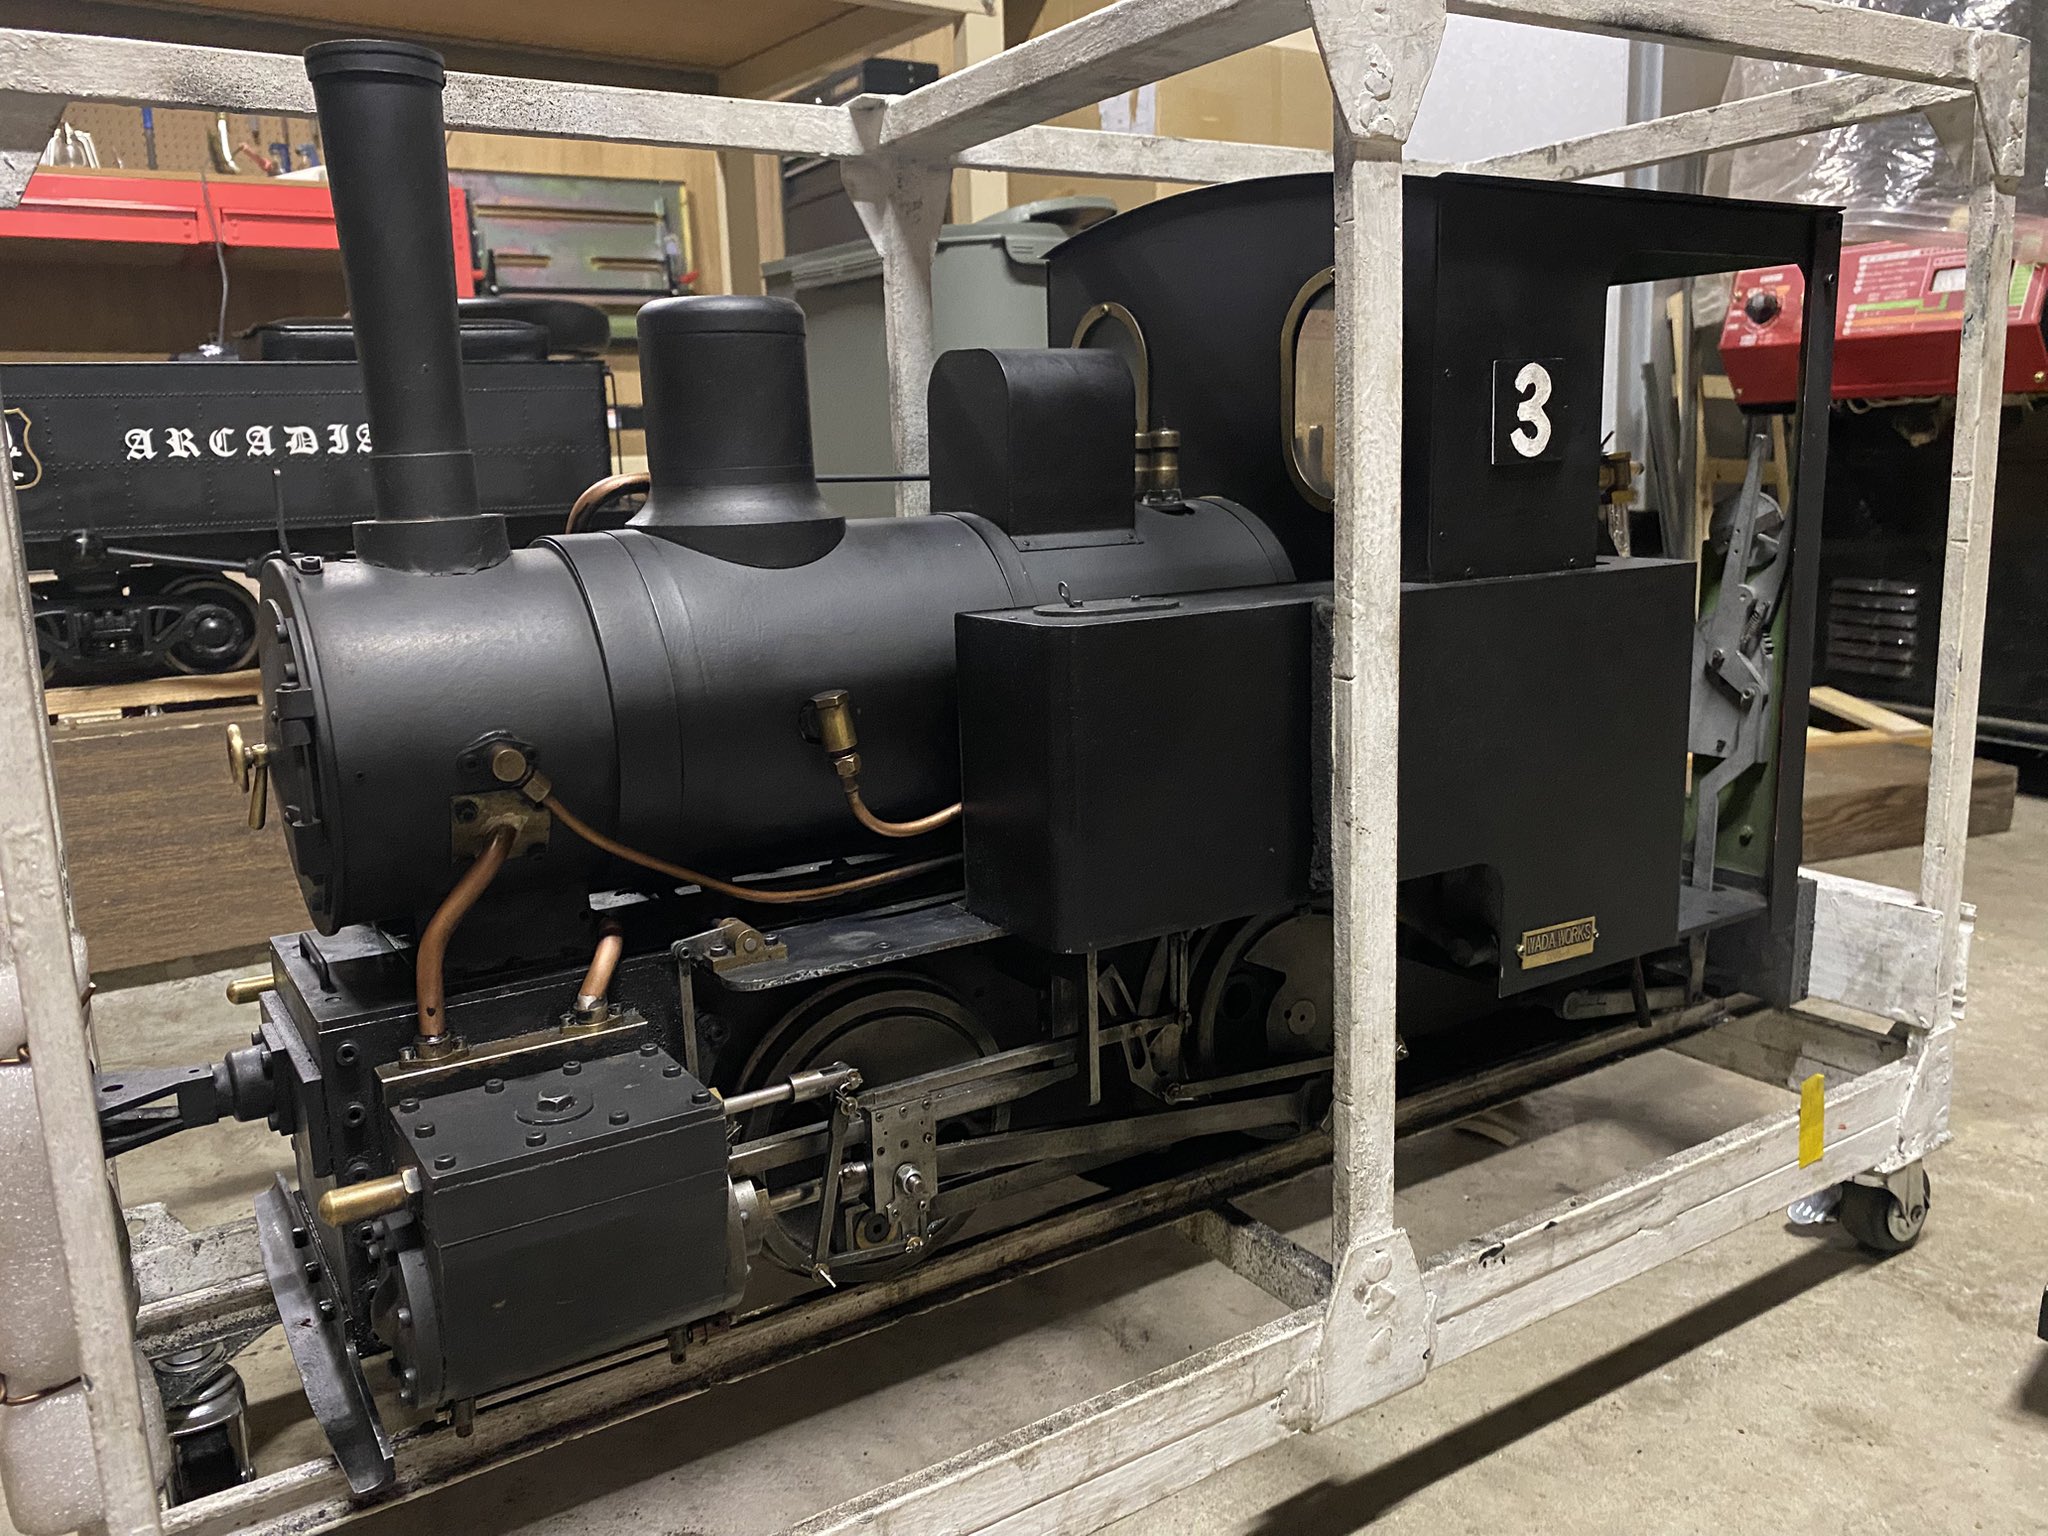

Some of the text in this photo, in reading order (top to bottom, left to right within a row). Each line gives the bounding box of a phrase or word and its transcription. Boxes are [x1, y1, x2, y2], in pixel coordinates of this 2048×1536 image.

[1510, 362, 1552, 458] 3
[1528, 923, 1592, 954] WADA WORKS
